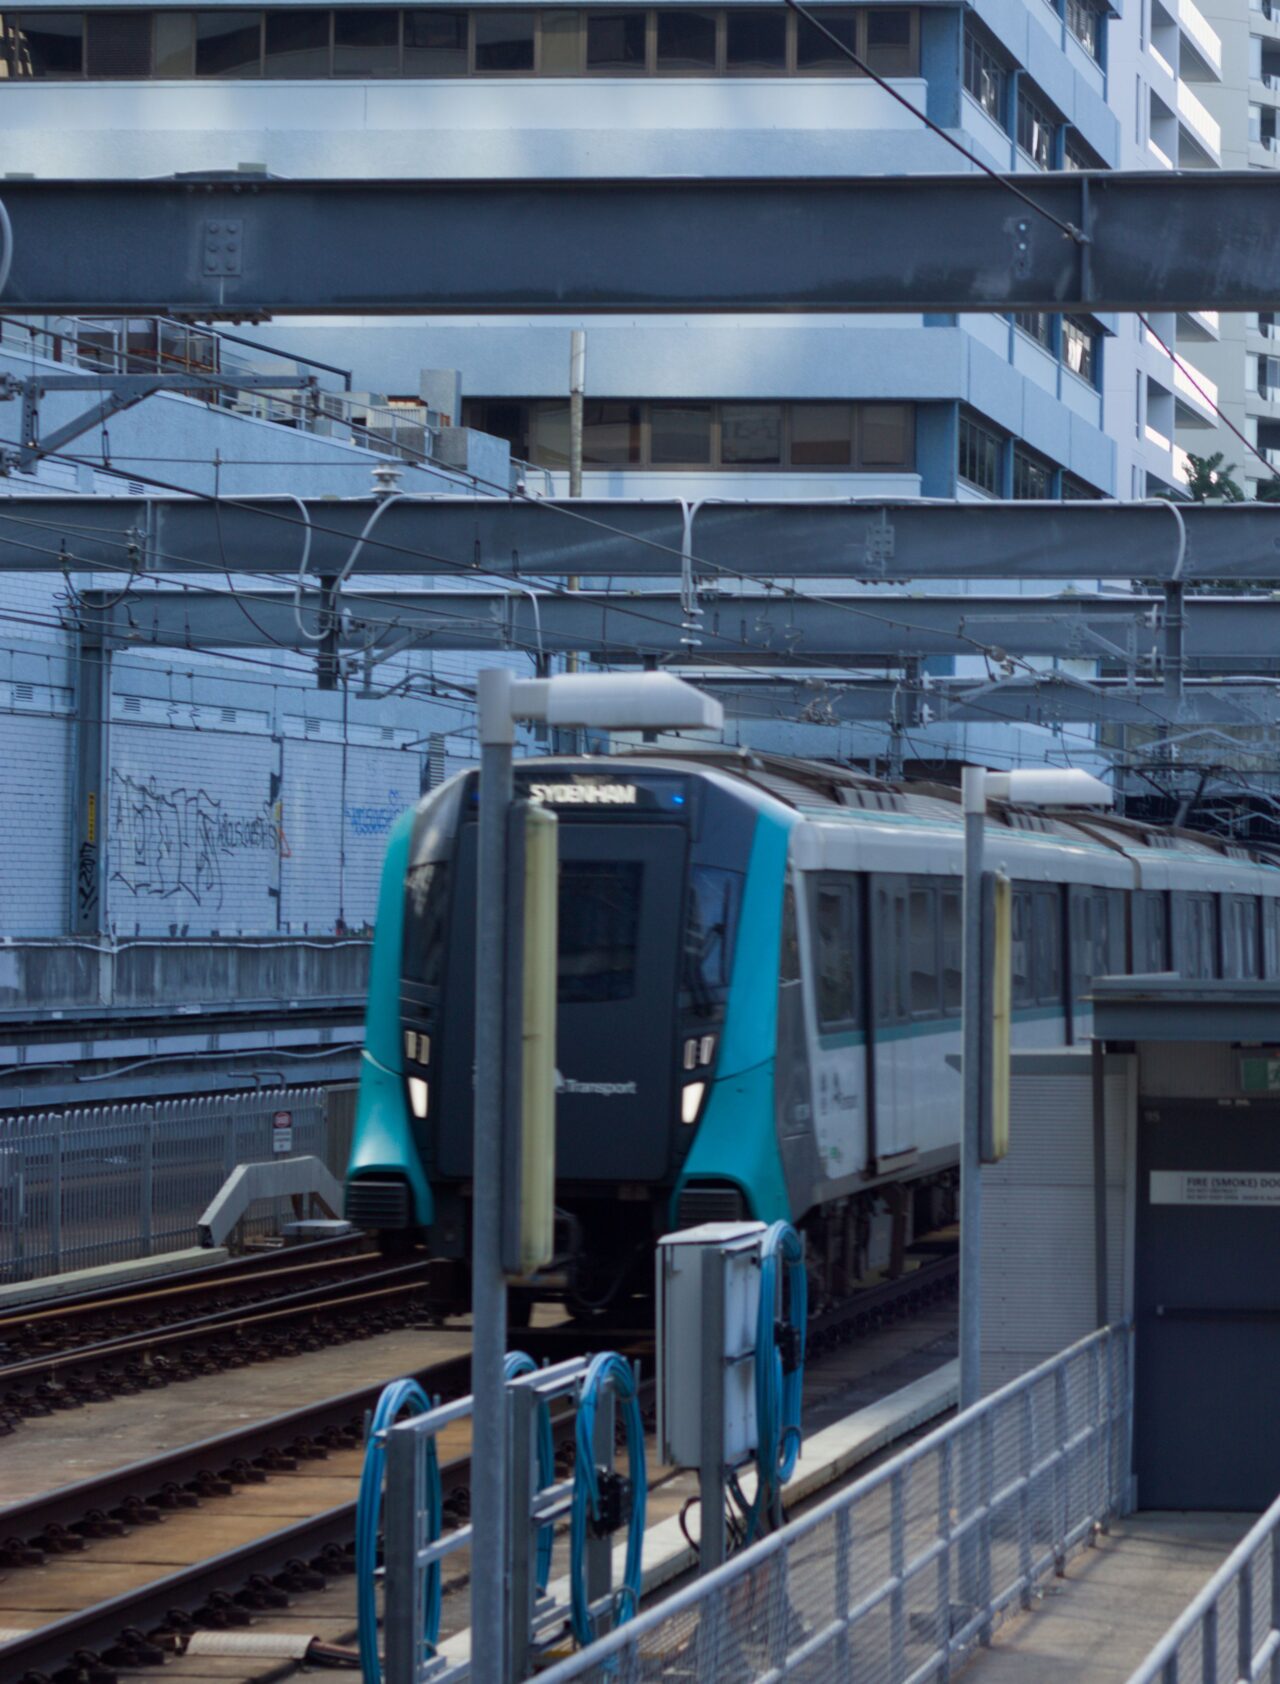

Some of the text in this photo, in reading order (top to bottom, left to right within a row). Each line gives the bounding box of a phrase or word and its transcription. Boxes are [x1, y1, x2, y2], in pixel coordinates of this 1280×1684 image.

[529, 784, 637, 804] SYDENHAM
[565, 1079, 638, 1098] Transport
[1186, 1177, 1208, 1188] FIRE
[1211, 1177, 1258, 1190] (SMOKE)
